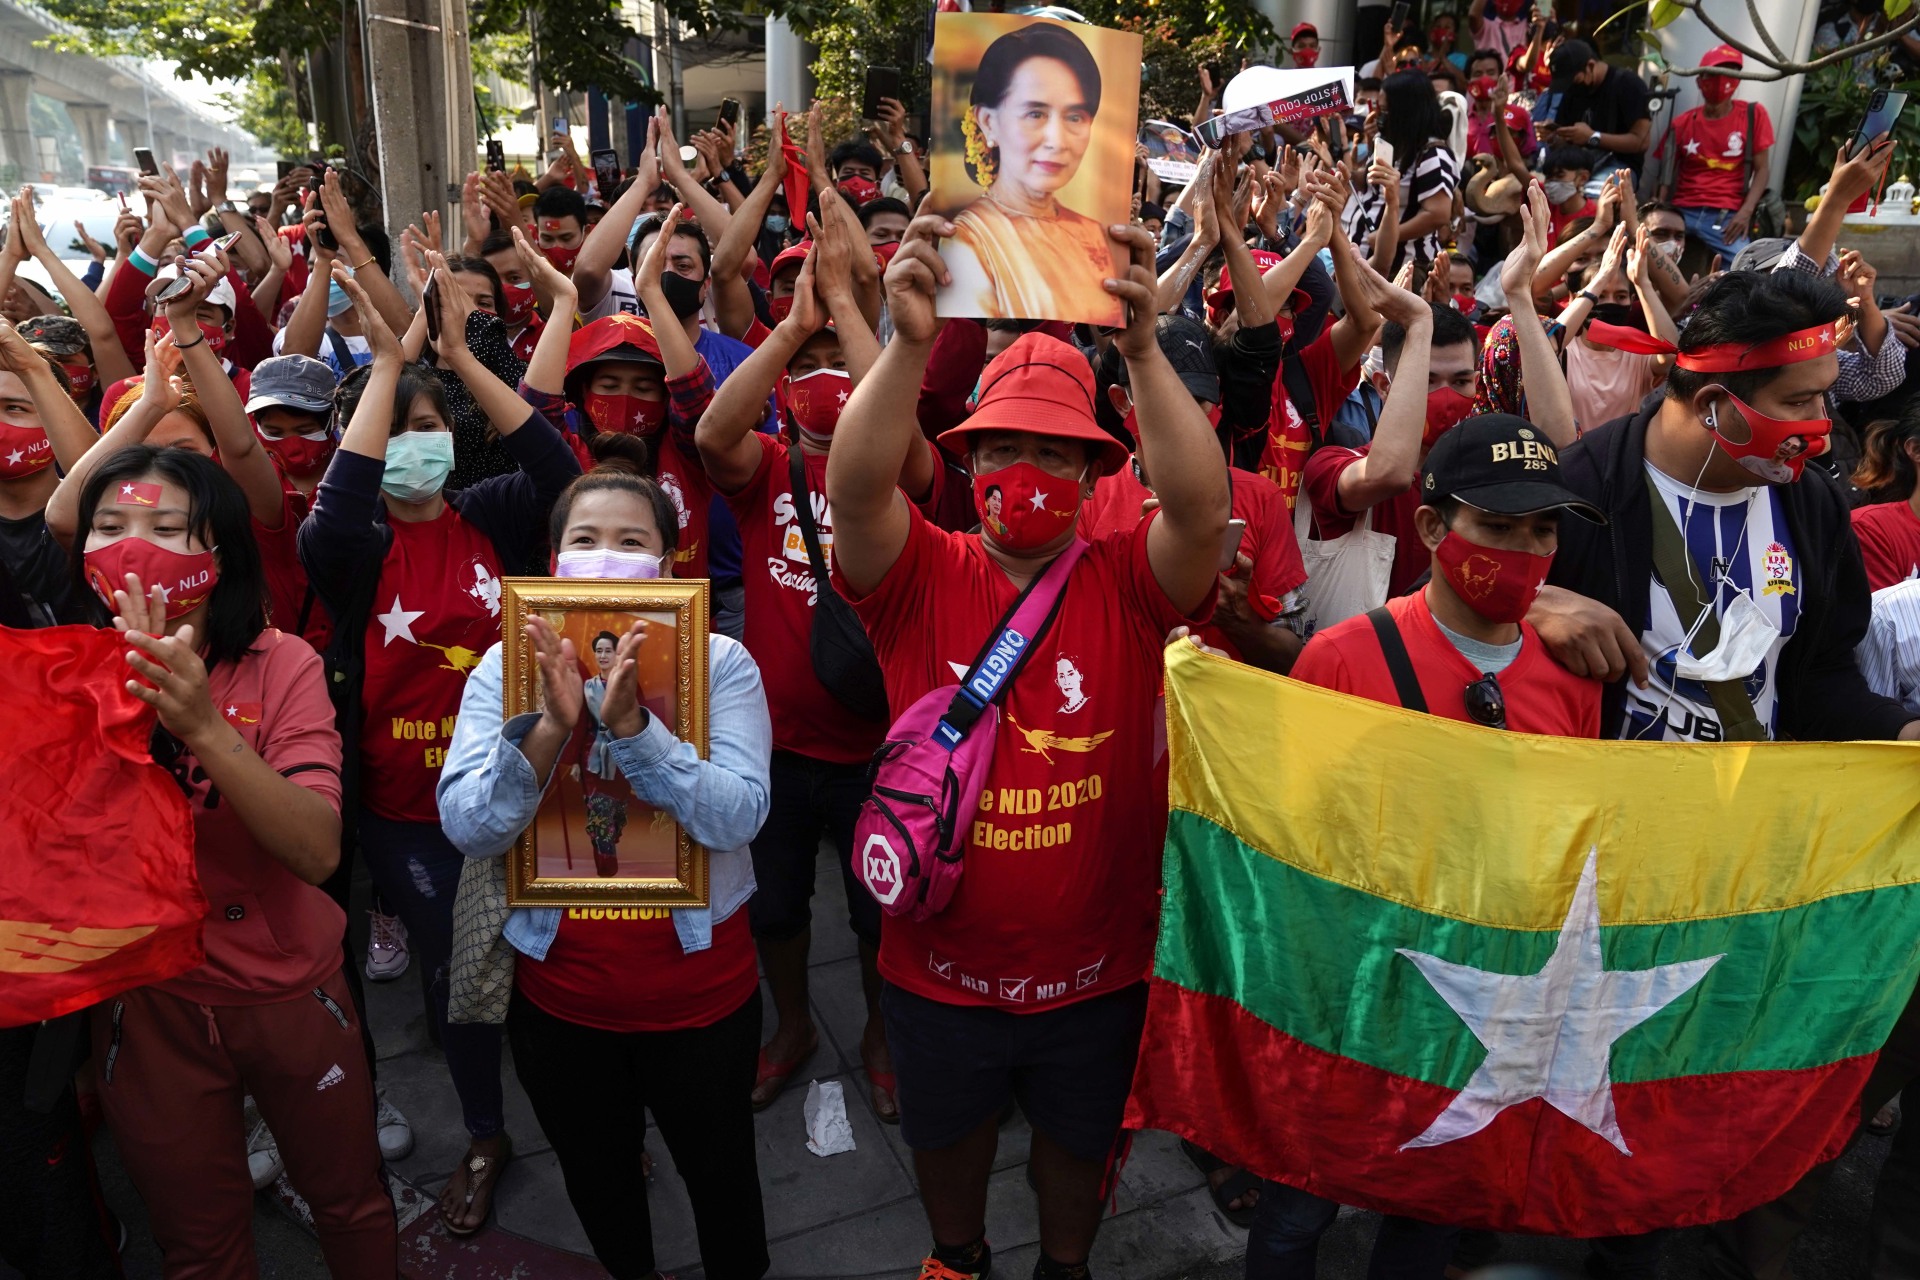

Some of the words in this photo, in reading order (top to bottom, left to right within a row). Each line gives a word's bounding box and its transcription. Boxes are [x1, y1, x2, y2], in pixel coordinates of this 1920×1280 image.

[1304, 85, 1339, 105] #STOP
[1273, 98, 1301, 116] COUP
[1788, 337, 1815, 352] NLD
[72, 374, 89, 384] NLD
[28, 438, 50, 455] NLD
[1491, 440, 1558, 466] BLEND
[1523, 459, 1548, 471] 285
[179, 569, 209, 592] NLD
[391, 717, 437, 740] Vote
[441, 714, 458, 738] N
[979, 788, 994, 812] e
[998, 788, 1042, 815] NLD
[1046, 774, 1102, 812] 2020
[972, 820, 1072, 851] Election
[868, 856, 896, 883] XX
[960, 973, 989, 994] NLD
[1036, 981, 1067, 1000] NLD
[316, 1071, 346, 1091] SPORT
